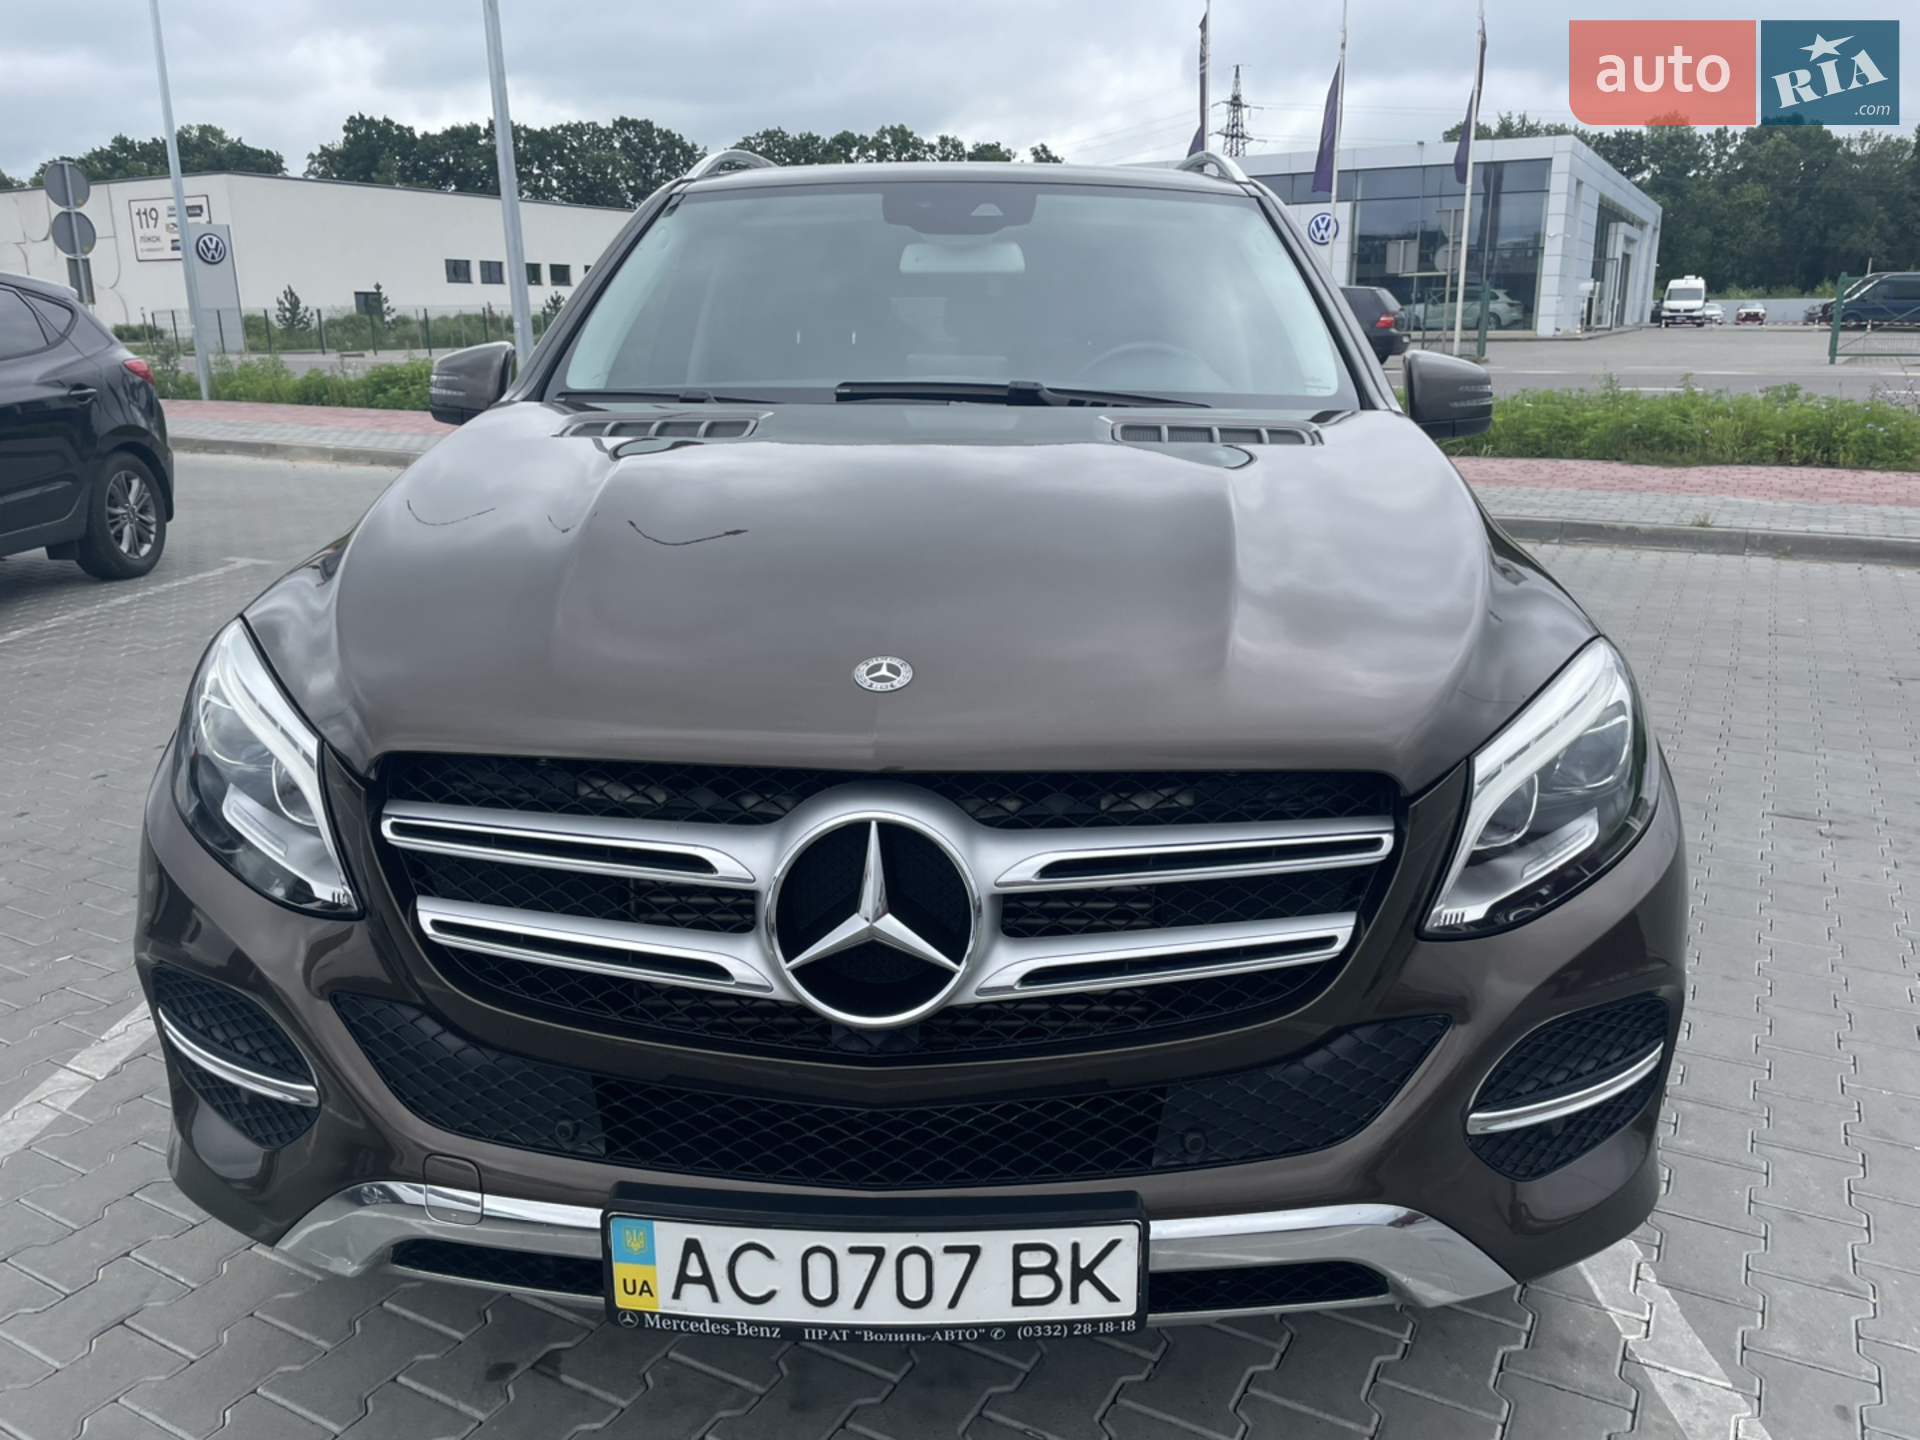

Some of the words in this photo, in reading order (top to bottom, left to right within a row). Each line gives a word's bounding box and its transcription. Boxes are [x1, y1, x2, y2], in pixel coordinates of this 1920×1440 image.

[135, 207, 159, 229] 119
[671, 1237, 779, 1306] AC
[800, 1244, 982, 1310] 0707
[1011, 1238, 1123, 1307] BK
[622, 1278, 655, 1298] UA
[644, 1312, 782, 1339] Mercedes-Benz
[803, 1327, 850, 1342] ПРАТ
[1016, 1324, 1069, 1341] (0332)
[1072, 1319, 1137, 1336] 28-18-18
